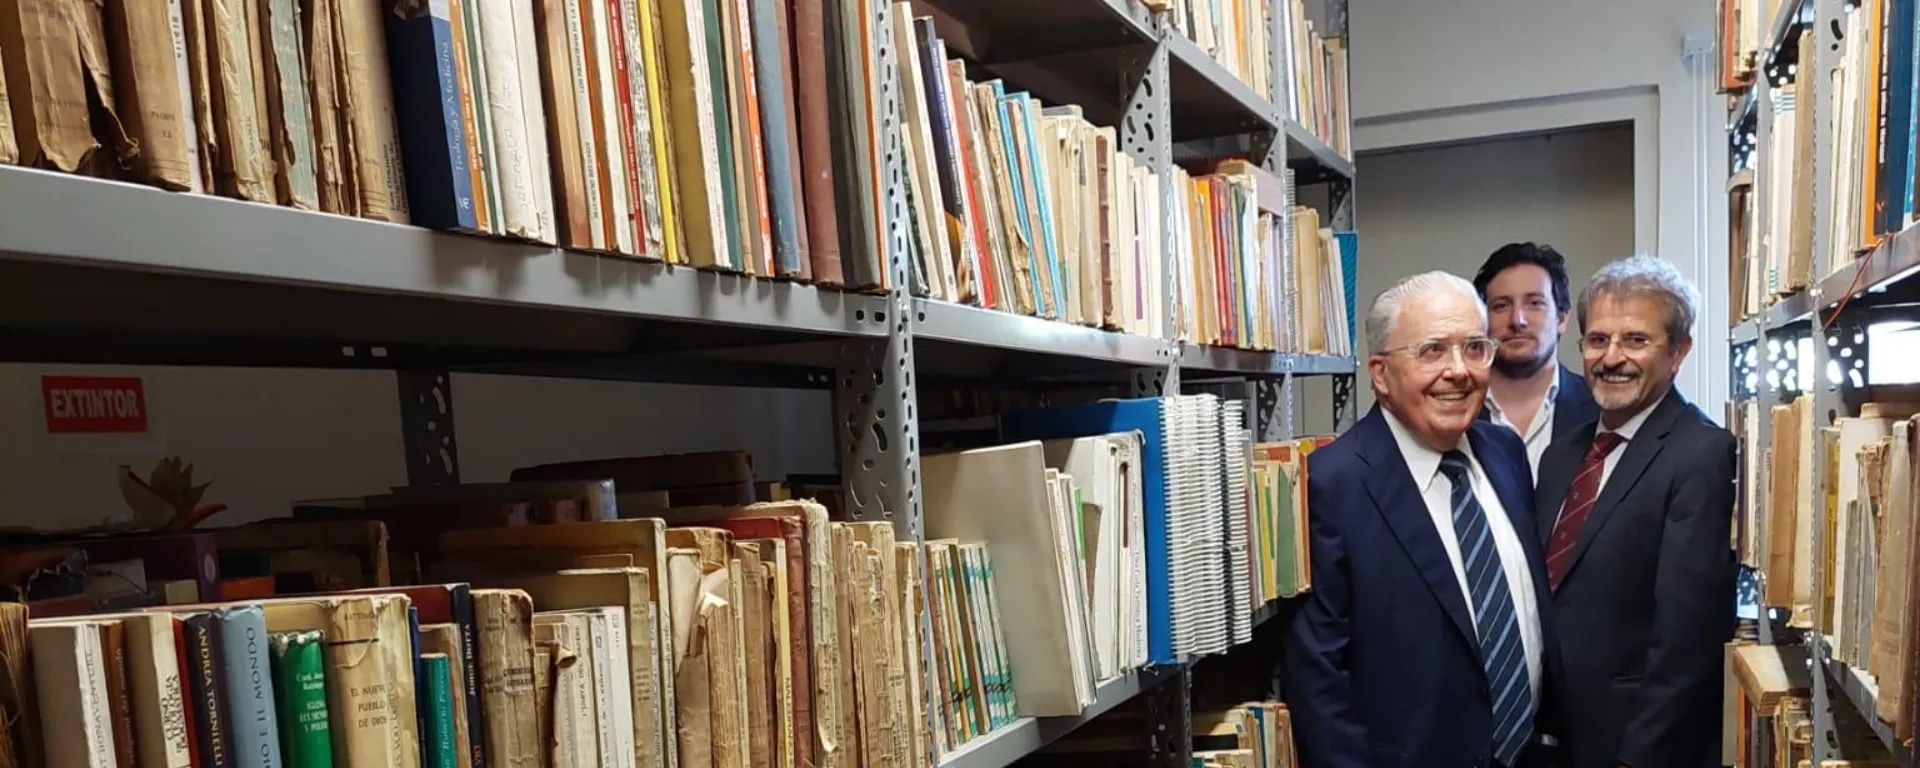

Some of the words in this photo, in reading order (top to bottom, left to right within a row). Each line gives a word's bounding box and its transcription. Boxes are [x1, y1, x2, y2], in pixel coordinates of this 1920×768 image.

[442, 41, 455, 103] Medicina
[50, 388, 140, 418] EXTINTOR
[464, 623, 472, 658] DOTTA
[246, 627, 263, 699] MONDO
[198, 626, 213, 685] ANDREA
[206, 689, 223, 766] TORNIELLI
[350, 687, 360, 697] EL
[358, 701, 386, 712] PUEBLO
[161, 698, 173, 740] CURSO
[358, 718, 369, 728] DE
